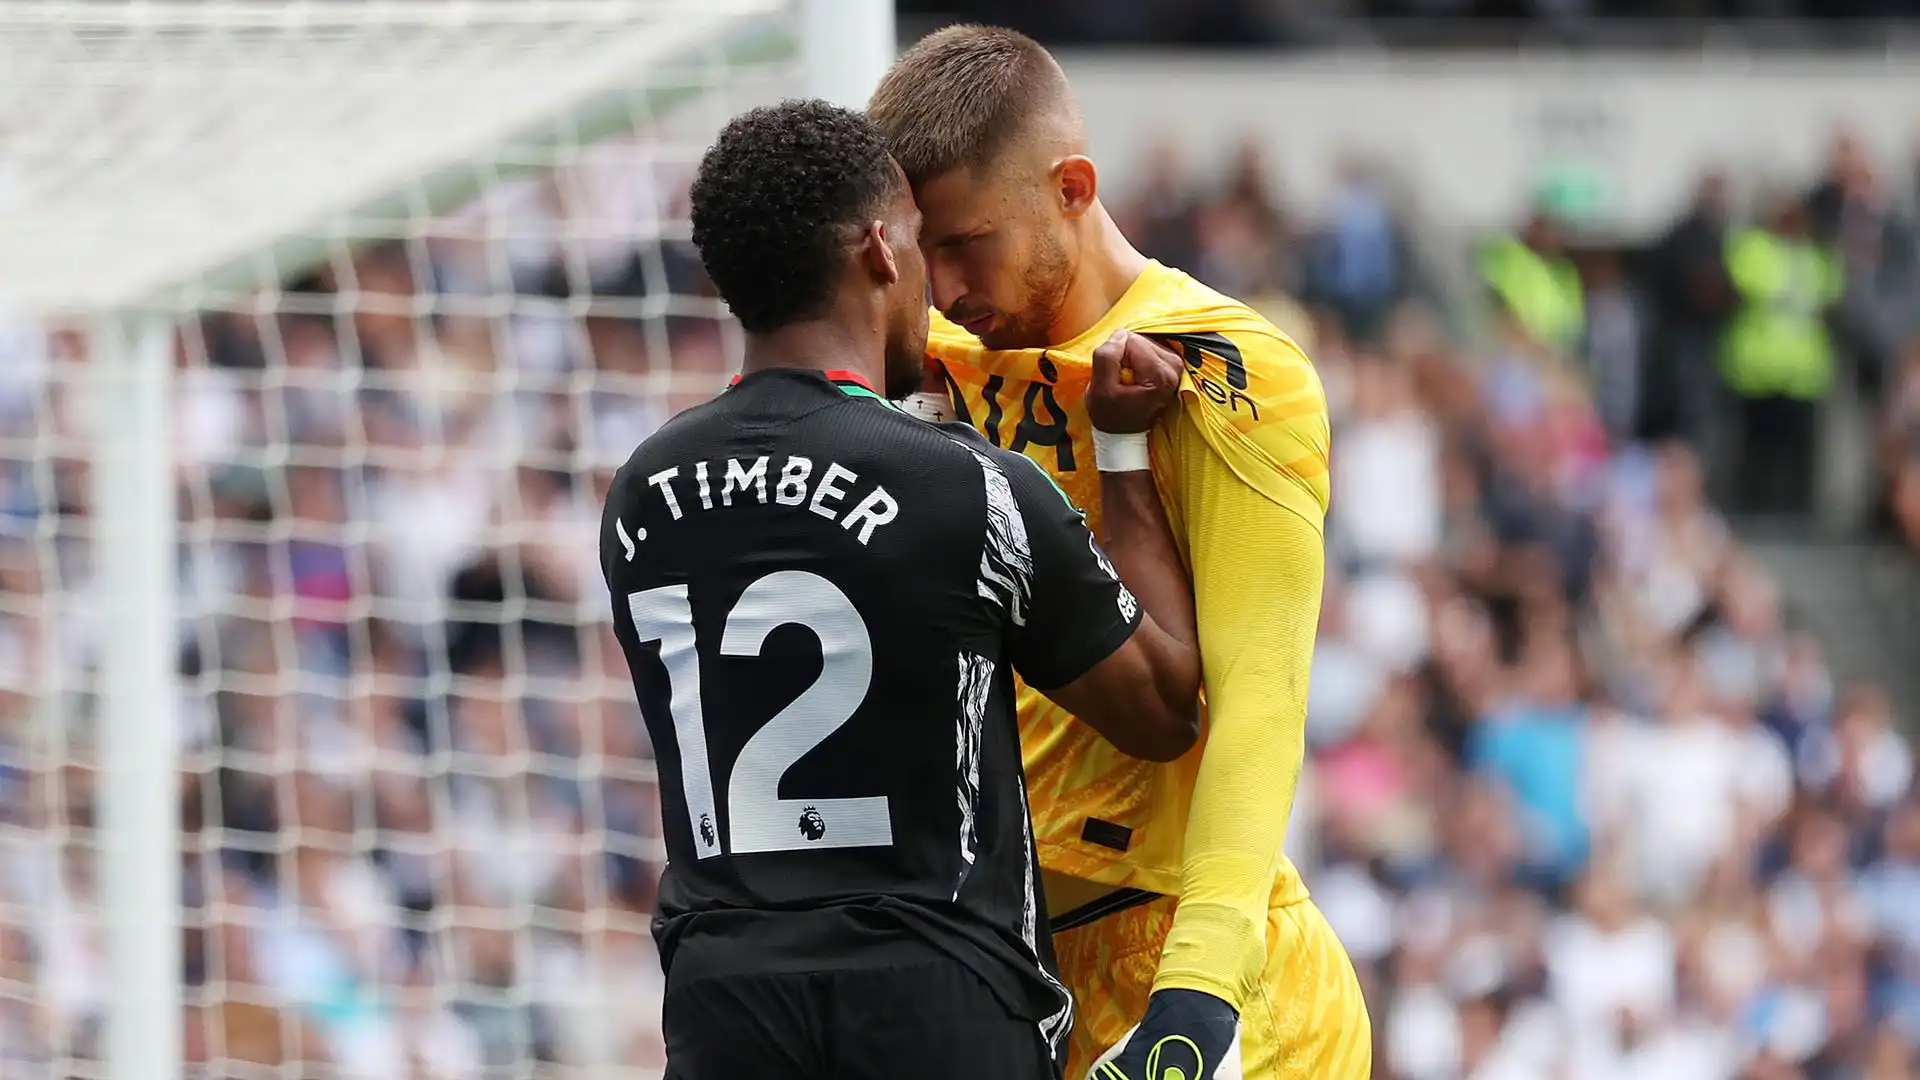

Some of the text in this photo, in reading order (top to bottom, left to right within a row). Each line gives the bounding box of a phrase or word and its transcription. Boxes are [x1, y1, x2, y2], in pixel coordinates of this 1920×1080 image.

[616, 456, 899, 562] J. TIMBER
[628, 570, 893, 859] 12
